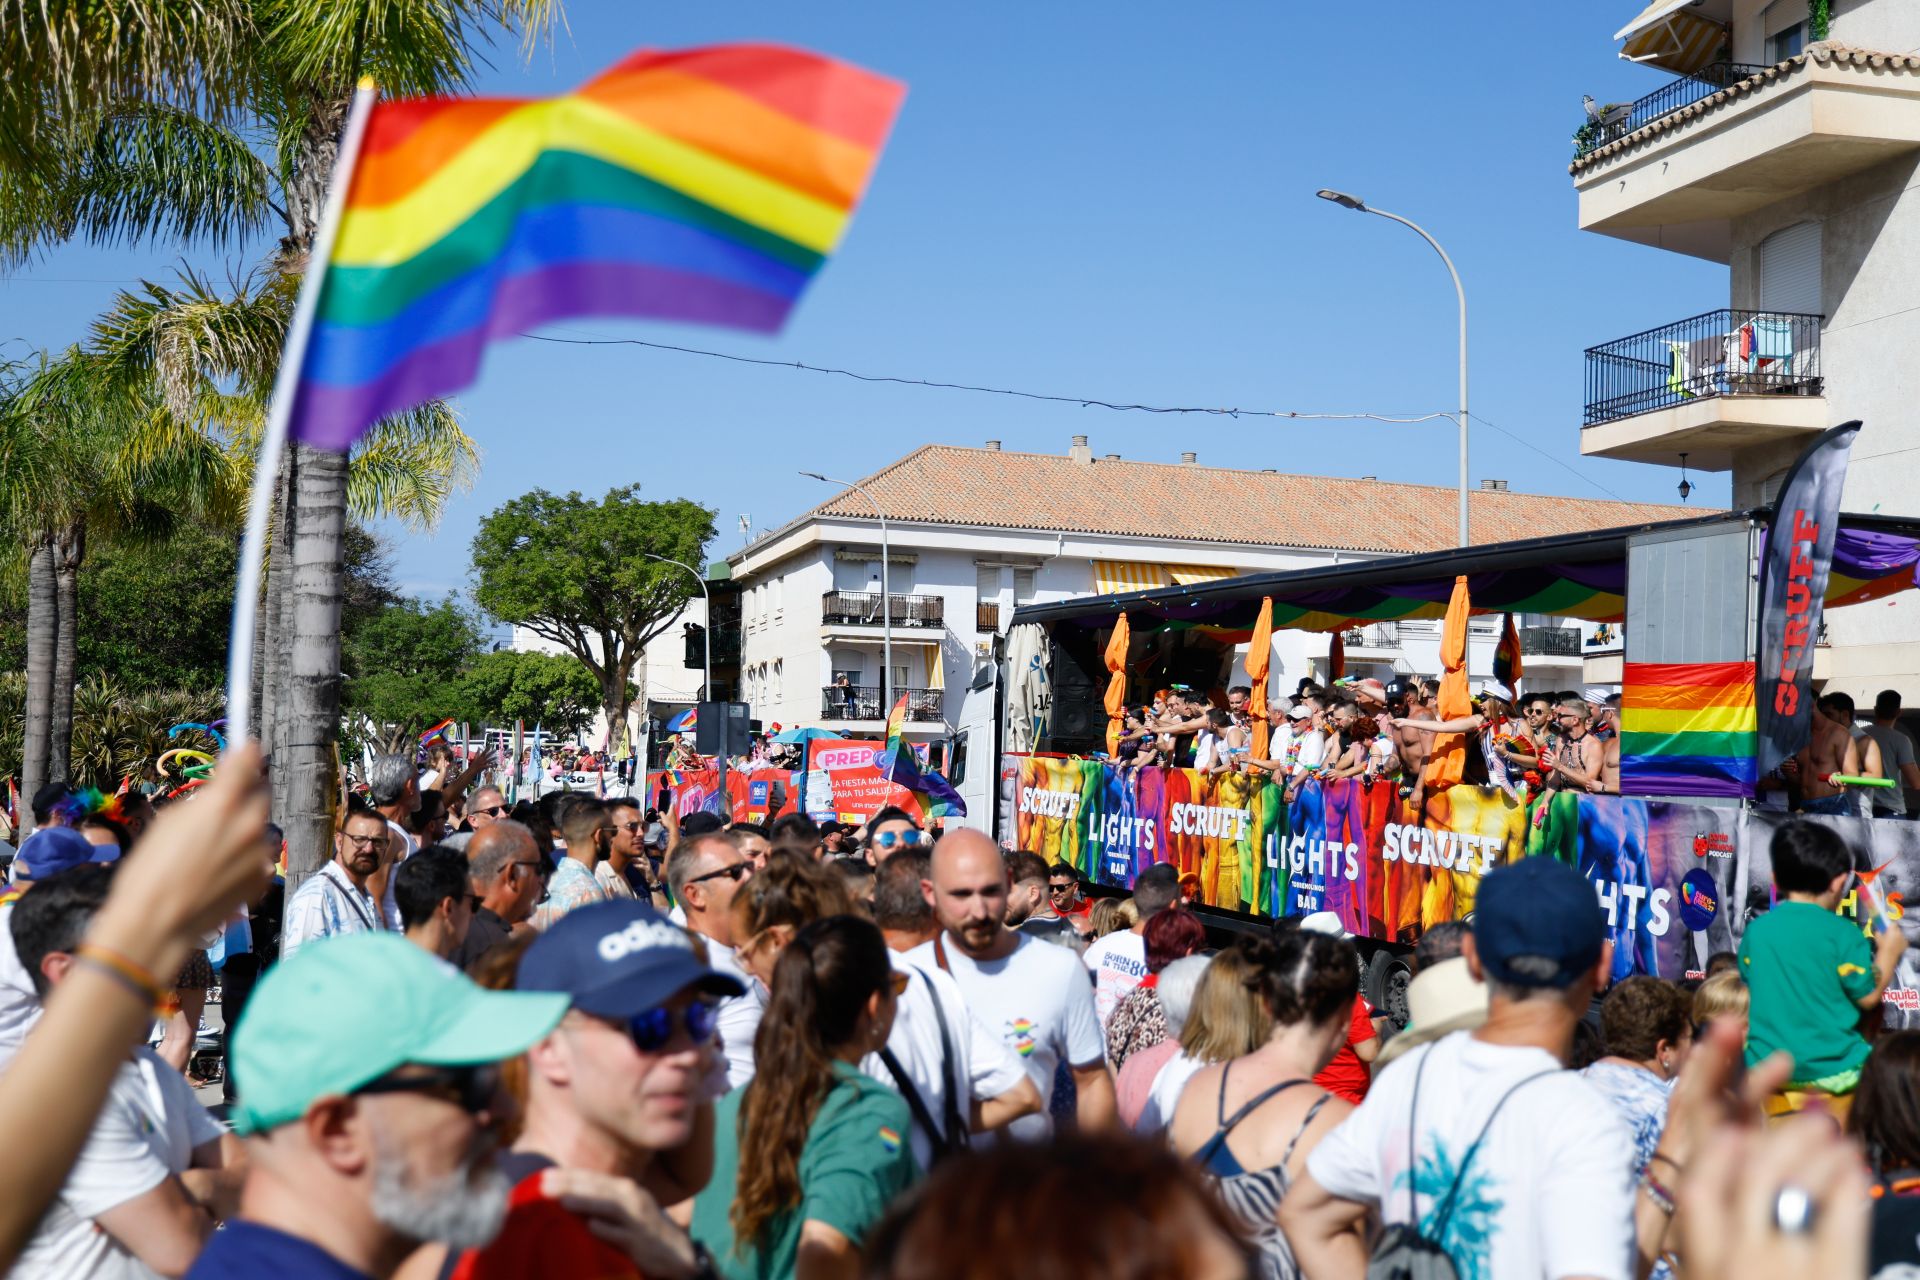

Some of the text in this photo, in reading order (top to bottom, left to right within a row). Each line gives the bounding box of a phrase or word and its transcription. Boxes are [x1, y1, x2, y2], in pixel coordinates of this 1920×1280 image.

[1775, 510, 1819, 716] SCRUFF
[825, 750, 873, 767] PREP
[553, 774, 585, 783] csa
[841, 776, 866, 787] FIESTA
[832, 789, 853, 799] PARA
[854, 787, 864, 797] TU
[865, 785, 893, 796] SALUD
[1019, 787, 1079, 820] SCRUFF
[1170, 802, 1250, 841] SCRUFF
[1088, 811, 1155, 851] LIGHTS
[1266, 828, 1360, 881] LIGHTS
[1382, 822, 1503, 876] SCRUFF
[1708, 850, 1733, 859] PODCAST
[1110, 862, 1126, 876] BAR
[1291, 881, 1325, 893] TORREMOLINOS
[1297, 894, 1318, 911] BAR
[1104, 951, 1131, 967] BORN
[1113, 963, 1130, 974] THE
[1904, 1000, 1919, 1009] fest
